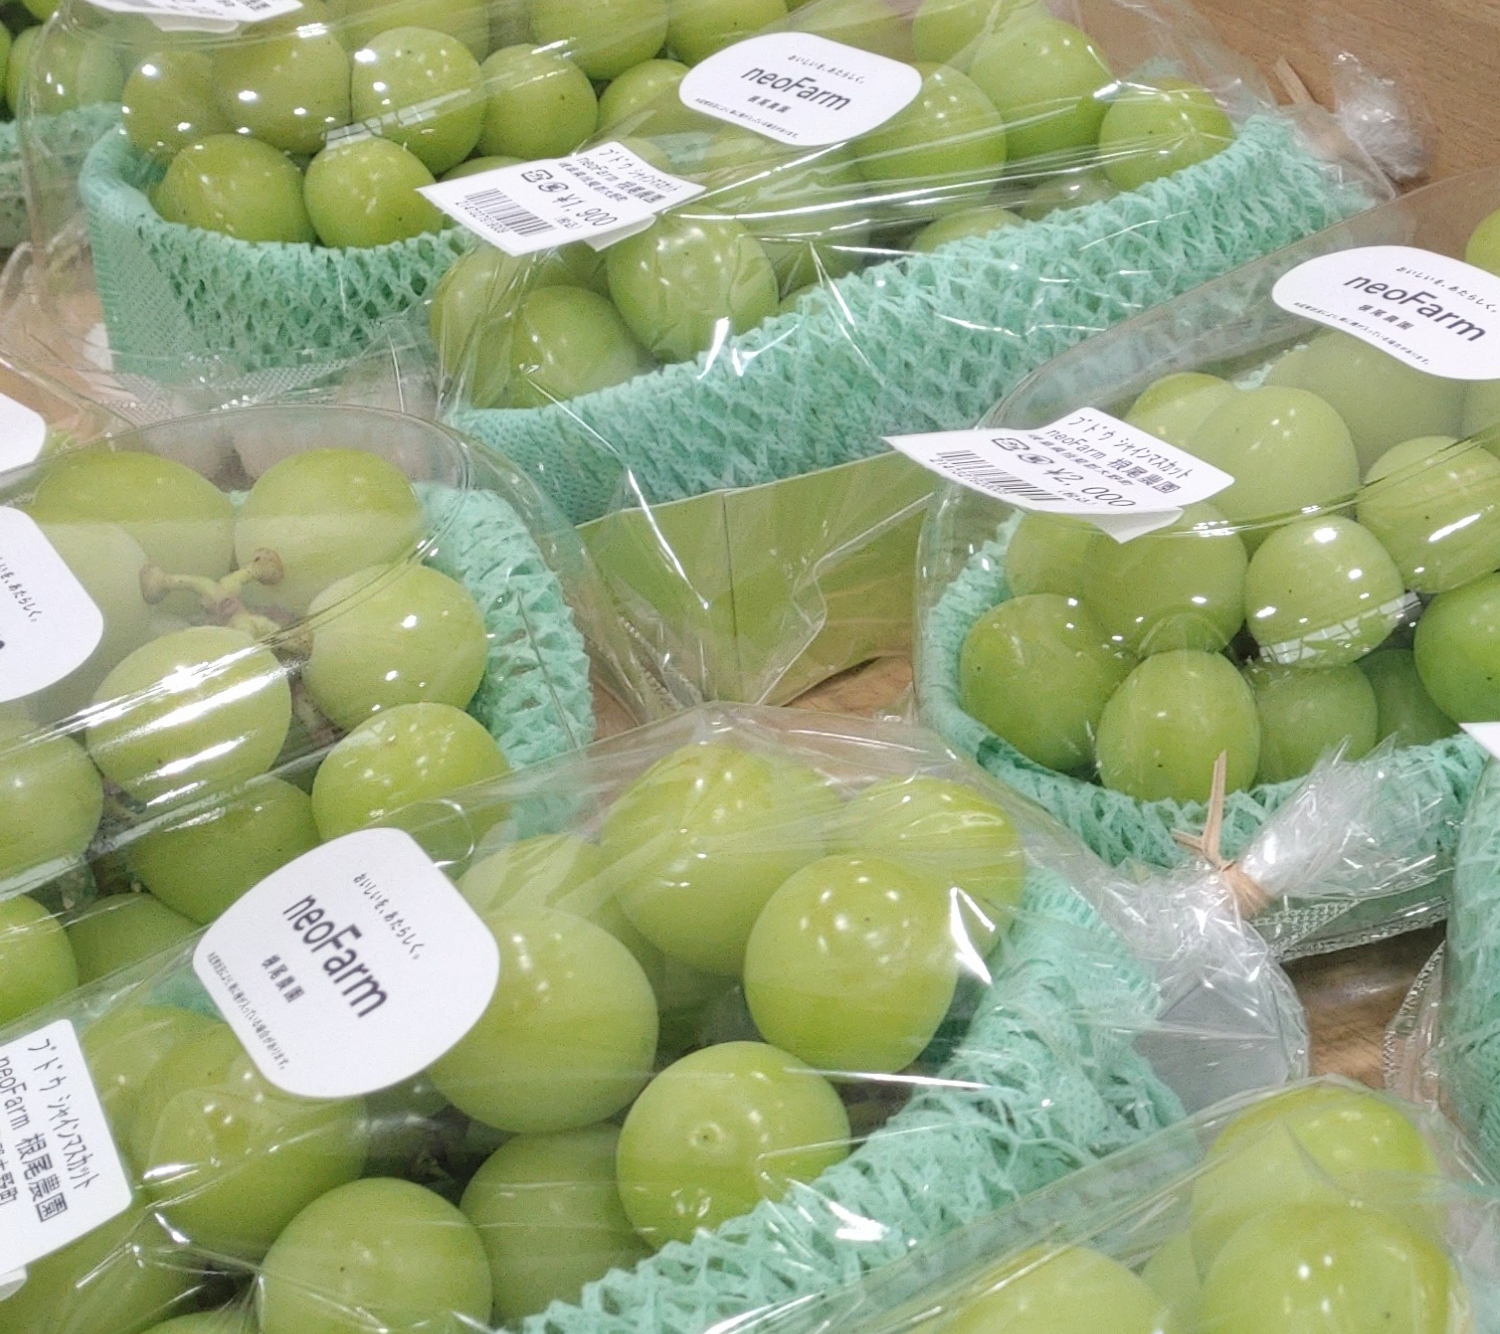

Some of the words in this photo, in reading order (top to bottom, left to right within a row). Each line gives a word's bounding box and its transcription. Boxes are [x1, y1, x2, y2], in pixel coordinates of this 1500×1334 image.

[741, 66, 852, 111] neoFarm
[553, 192, 618, 227] ¥1,900
[1343, 275, 1486, 342] neoFarm
[1046, 429, 1107, 460] neoFarm
[1068, 416, 1115, 441] ブドウ
[1113, 438, 1194, 479] シャインマスカット
[1044, 467, 1137, 507] ¥2,000
[282, 894, 388, 1019] neoFarm
[27, 1038, 68, 1092] ブドウ
[47, 1093, 100, 1191] シャインマスカット
[15, 1131, 69, 1223] 根尾農園
